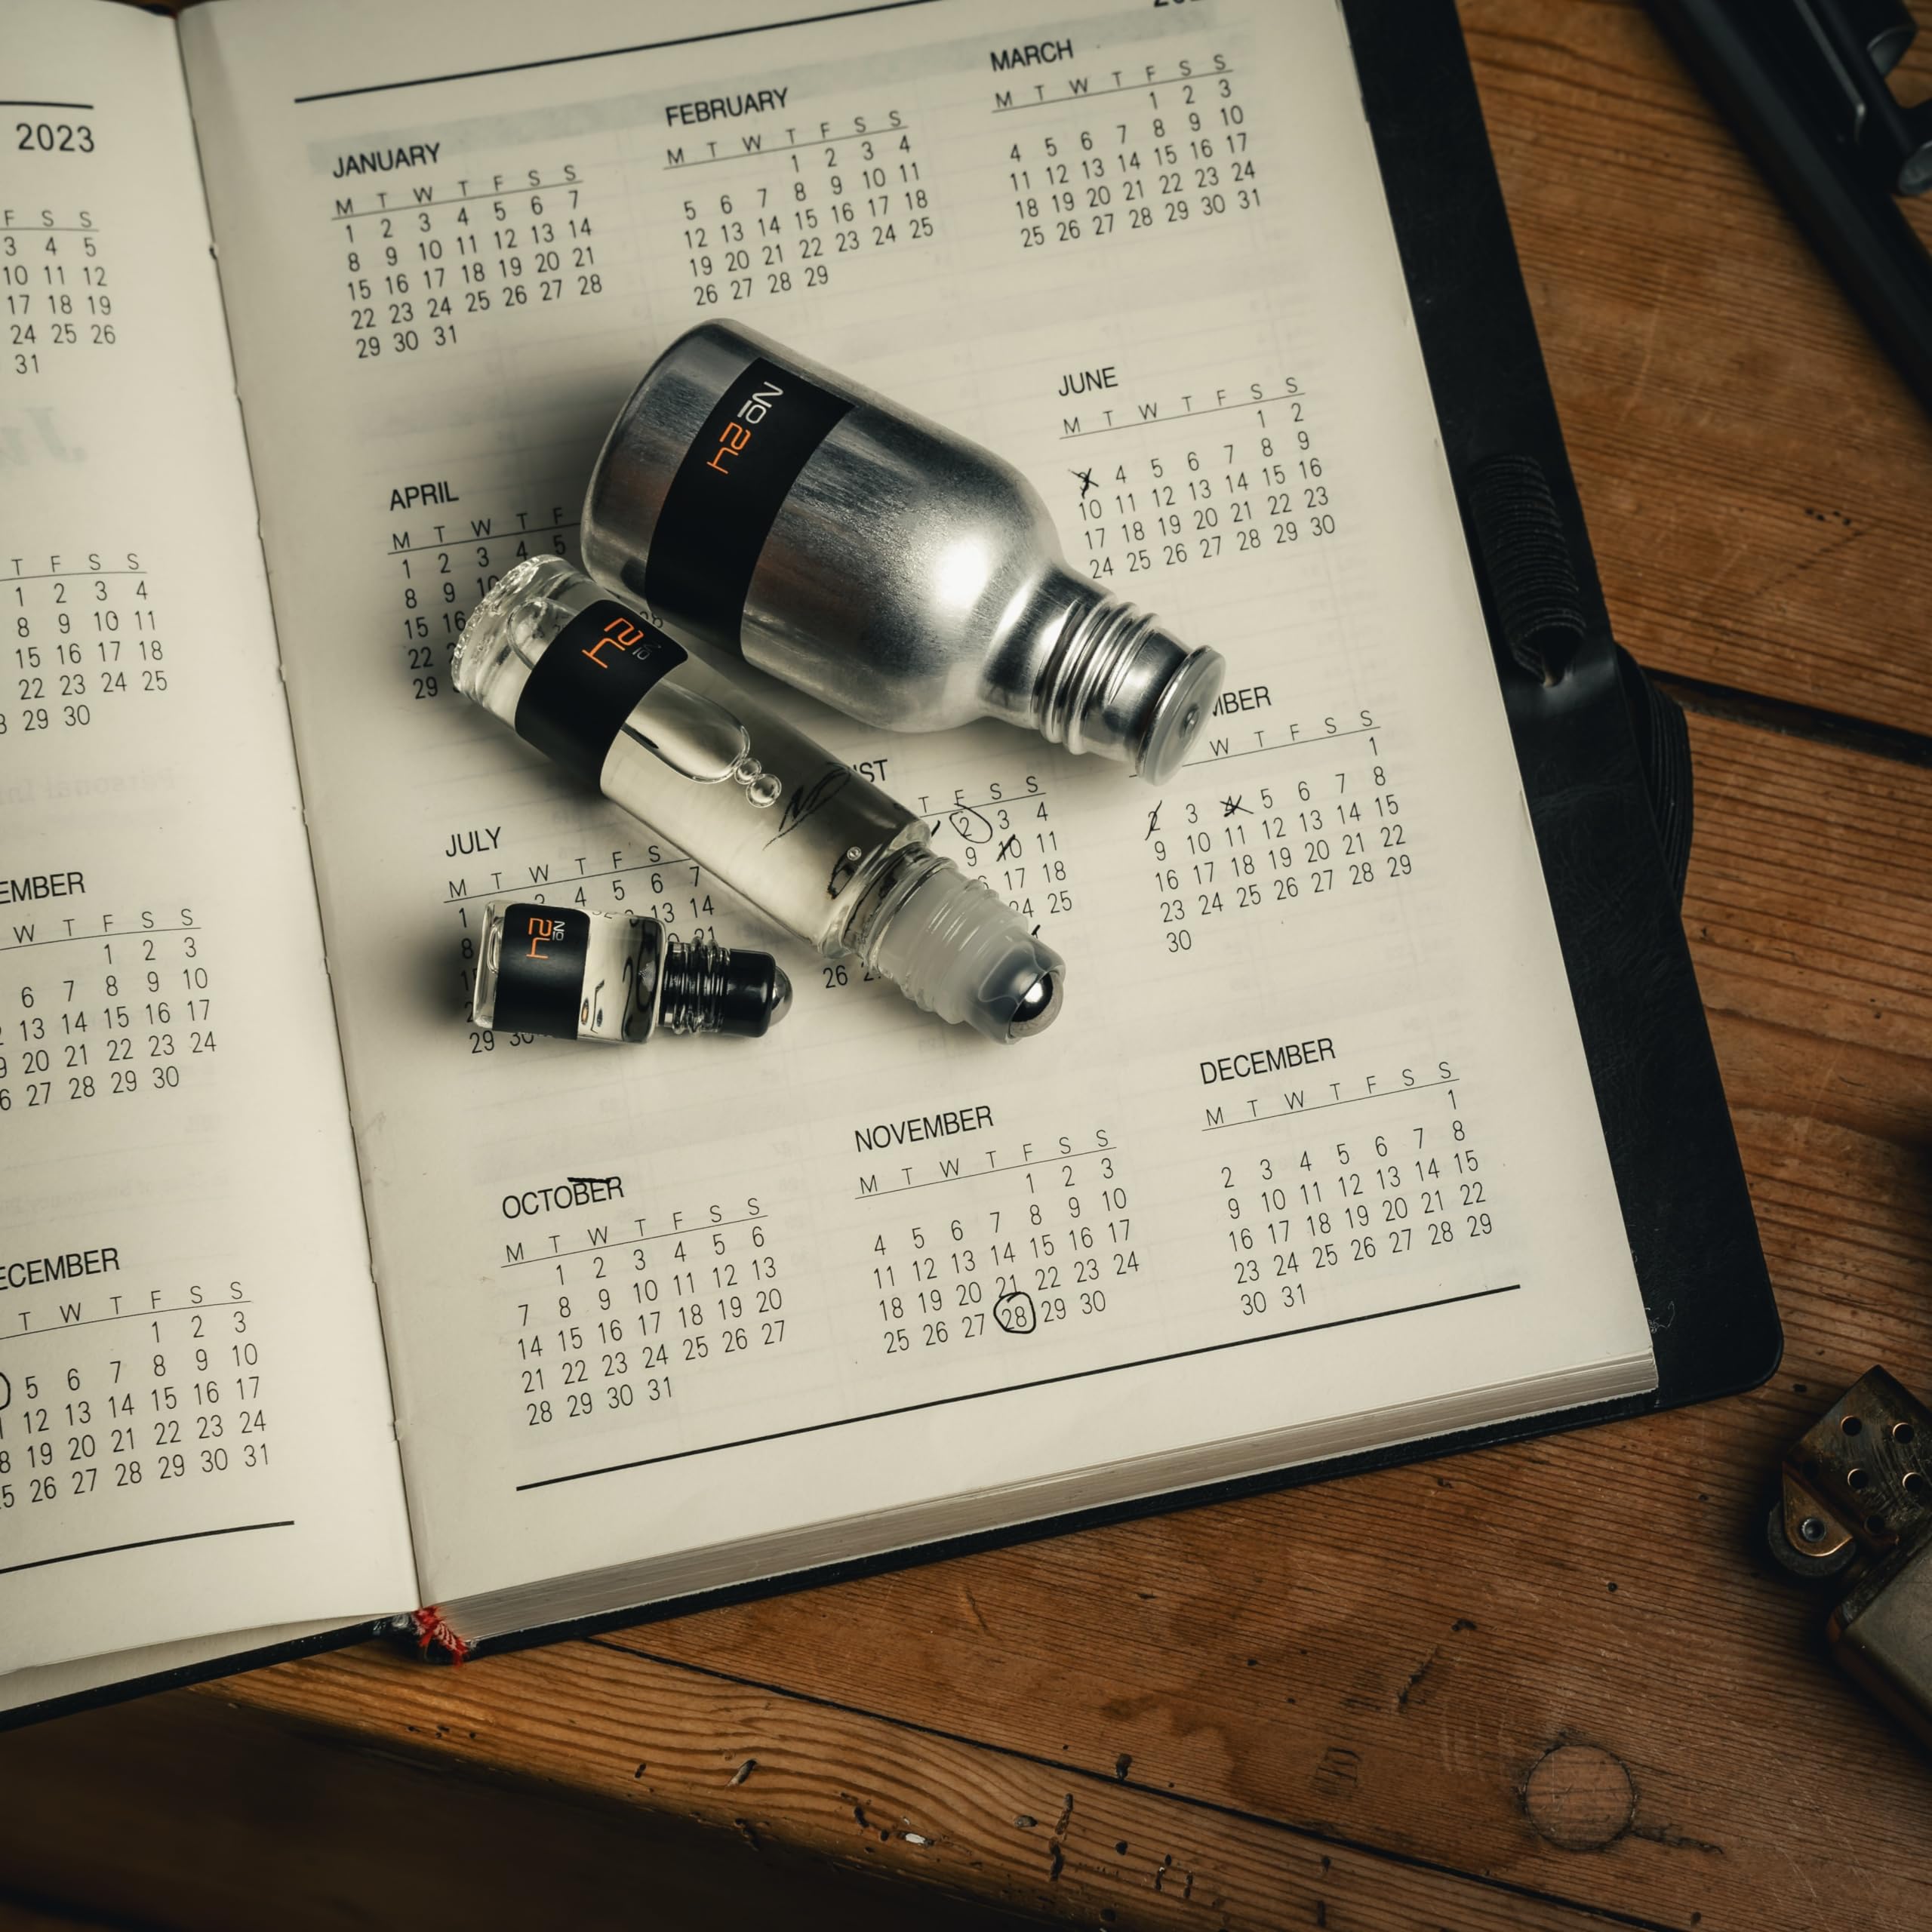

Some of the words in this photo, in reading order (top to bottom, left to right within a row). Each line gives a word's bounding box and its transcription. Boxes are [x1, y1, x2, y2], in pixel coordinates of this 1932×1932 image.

[989, 38, 1074, 72] MARCH
[665, 87, 788, 128] FEBRUARY
[16, 122, 95, 153] 2023
[332, 142, 441, 179] JANUARY
[335, 198, 354, 215] M
[376, 192, 388, 208] T
[413, 186, 432, 204] W
[457, 180, 469, 196] T
[492, 175, 503, 191] F
[528, 170, 540, 187] S
[564, 165, 576, 182] S
[685, 227, 707, 248] 12
[721, 221, 744, 243] 13
[758, 215, 781, 236] 14
[795, 208, 818, 230] 15
[831, 202, 854, 224] 16
[868, 195, 888, 217] 17
[905, 189, 928, 211] 18
[1020, 225, 1044, 248] 25
[1057, 219, 1081, 242] 26
[1092, 213, 1114, 235] 27
[1128, 207, 1153, 229] 28
[1164, 200, 1189, 223] 29
[1201, 194, 1226, 216] 30
[1238, 188, 1260, 210] 31
[347, 252, 361, 272] 8
[385, 246, 398, 266] 9
[419, 239, 442, 260] 10
[457, 235, 477, 256] 11
[494, 228, 518, 250] 12
[531, 223, 555, 245] 13
[568, 217, 592, 238] 14
[3, 265, 28, 285] 10
[44, 265, 64, 285] 11
[83, 266, 106, 287] 12
[694, 284, 718, 306] 26
[730, 277, 752, 300] 27
[768, 272, 792, 294] 28
[804, 265, 829, 288] 29
[7, 294, 30, 315] 17
[48, 294, 72, 315] 18
[88, 295, 112, 315] 19
[10, 324, 36, 345] 24
[51, 323, 77, 344] 25
[91, 324, 115, 345] 26
[355, 336, 381, 359] 29
[393, 330, 419, 353] 30
[433, 324, 457, 346] 31
[14, 353, 38, 375] 31
[1058, 366, 1119, 397] JUNE
[389, 481, 460, 512] APRIL
[1089, 556, 1114, 580] 24
[1127, 549, 1151, 573] 25
[1163, 543, 1188, 566] 26
[1199, 535, 1221, 558] 27
[1236, 528, 1261, 551] 28
[1273, 521, 1298, 544] 29
[1310, 514, 1335, 537] 30
[404, 616, 429, 640] 15
[442, 610, 466, 634] 16
[408, 645, 434, 670] 22
[18, 677, 45, 700] 22
[60, 673, 86, 696] 23
[100, 671, 128, 693] 24
[142, 670, 168, 691] 25
[412, 675, 438, 700] 29
[22, 708, 49, 731] 29
[63, 704, 91, 727] 30
[445, 826, 501, 858] JULY
[964, 846, 977, 867] 9
[1036, 830, 1057, 854] 11
[574, 886, 587, 907] 4
[612, 879, 626, 901] 5
[651, 872, 664, 894] 6
[688, 865, 700, 888] 7
[1004, 867, 1025, 891] 17
[1042, 860, 1066, 884] 18
[1160, 899, 1185, 923] 23
[1198, 891, 1224, 915] 24
[1236, 883, 1261, 909] 25
[1273, 876, 1299, 900] 26
[1311, 869, 1333, 894] 27
[1349, 862, 1374, 885] 28
[1386, 854, 1412, 878] 29
[651, 902, 675, 924] 13
[690, 894, 715, 918] 14
[1047, 890, 1072, 914] 25
[1166, 929, 1192, 953] 30
[823, 964, 848, 989] 26
[20, 1017, 45, 1041] 13
[61, 1011, 88, 1035] 14
[103, 1005, 130, 1029] 15
[145, 1001, 171, 1025] 16
[187, 998, 210, 1022] 17
[469, 1029, 495, 1054] 29
[1200, 1037, 1337, 1085] DECEMBER
[854, 1105, 995, 1153] NOVEMBER
[502, 1176, 625, 1220] OCTOBER
[1229, 1228, 1254, 1252] 16
[1267, 1220, 1289, 1244] 17
[1306, 1212, 1331, 1237] 18
[1345, 1204, 1369, 1229] 19
[1382, 1197, 1408, 1223] 20
[1421, 1189, 1444, 1214] 21
[1460, 1181, 1486, 1206] 22
[873, 1265, 895, 1290] 11
[912, 1257, 938, 1282] 12
[951, 1250, 976, 1274] 13
[990, 1241, 1016, 1266] 14
[1029, 1234, 1054, 1259] 15
[1069, 1226, 1094, 1251] 16
[1108, 1218, 1130, 1244] 17
[1240, 1291, 1267, 1316] 30
[1281, 1283, 1306, 1308] 31
[518, 1334, 543, 1360] 14
[558, 1326, 583, 1352] 15
[598, 1319, 623, 1344] 16
[638, 1310, 660, 1337] 17
[678, 1303, 703, 1328] 18
[718, 1296, 743, 1321] 19
[755, 1287, 783, 1314] 20
[884, 1328, 909, 1354] 25
[922, 1321, 949, 1346] 26
[961, 1312, 985, 1339] 27
[1001, 1306, 1027, 1330] 28
[1041, 1297, 1066, 1323] 29
[1080, 1290, 1106, 1315] 30
[526, 1400, 553, 1426] 28
[567, 1392, 593, 1418] 29
[607, 1383, 633, 1409] 30
[648, 1376, 672, 1401] 31
[29, 1475, 57, 1503] 26
[72, 1467, 97, 1495] 27
[115, 1460, 143, 1487] 28
[158, 1454, 185, 1480] 29
[200, 1447, 228, 1473] 30
[243, 1443, 268, 1468] 31
